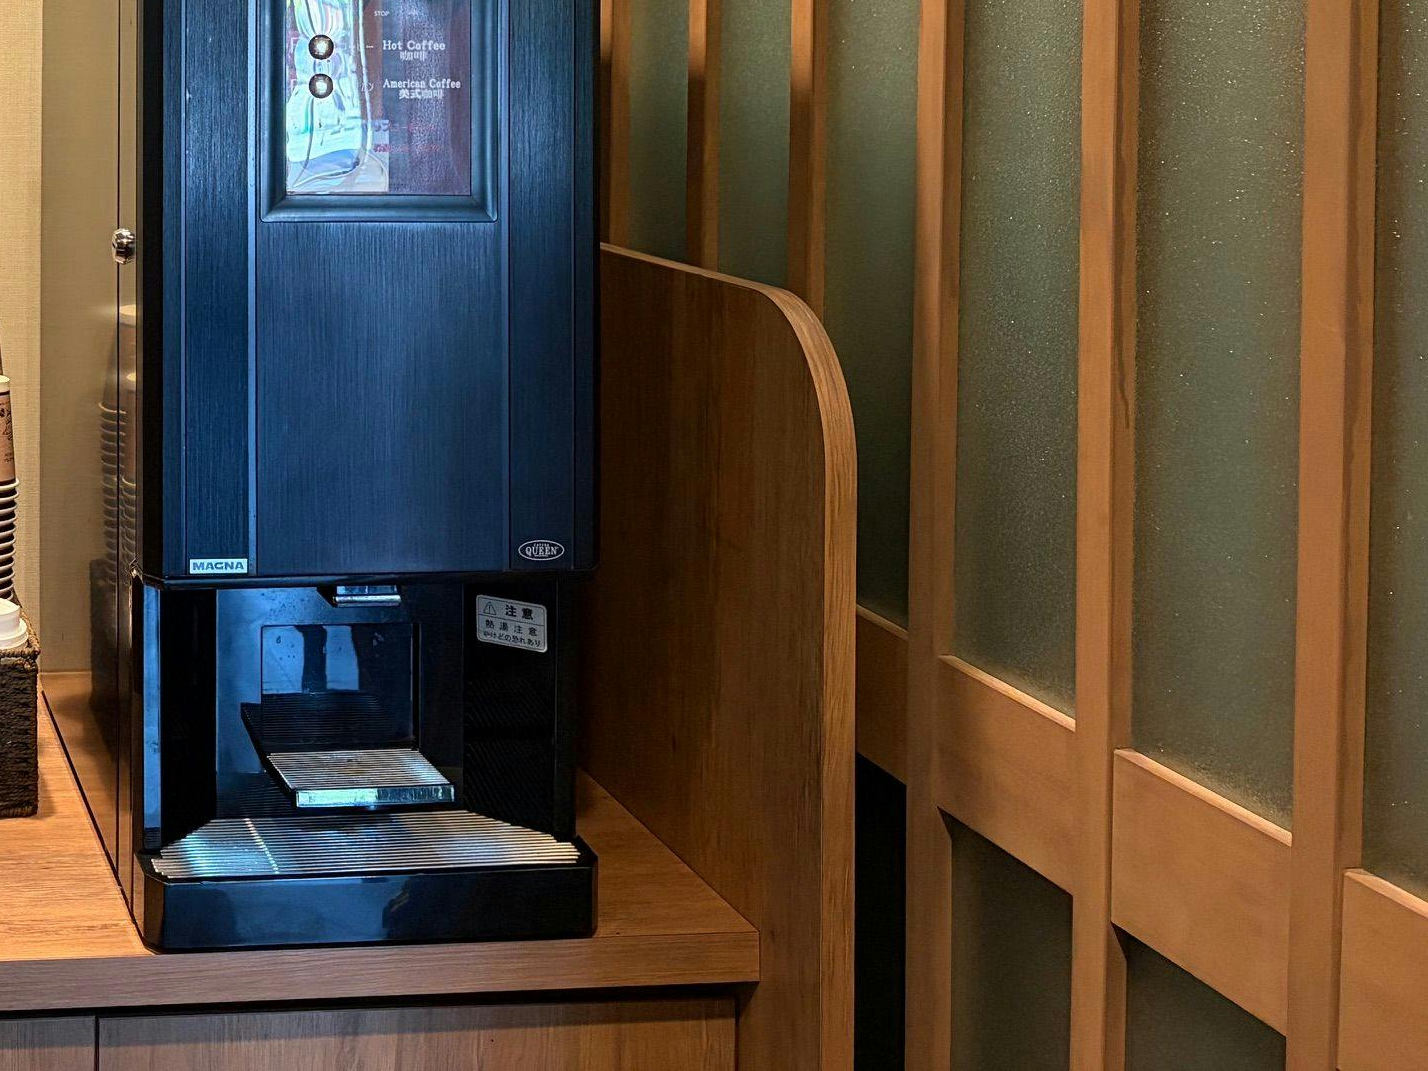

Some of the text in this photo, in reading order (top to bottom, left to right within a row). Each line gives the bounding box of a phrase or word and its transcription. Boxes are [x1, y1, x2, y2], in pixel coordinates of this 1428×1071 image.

[382, 40, 446, 50] Hot Coffee
[382, 78, 461, 89] American Coffee
[525, 546, 557, 557] QUEEN
[192, 560, 245, 572] MAGNA
[505, 604, 534, 620] 注意
